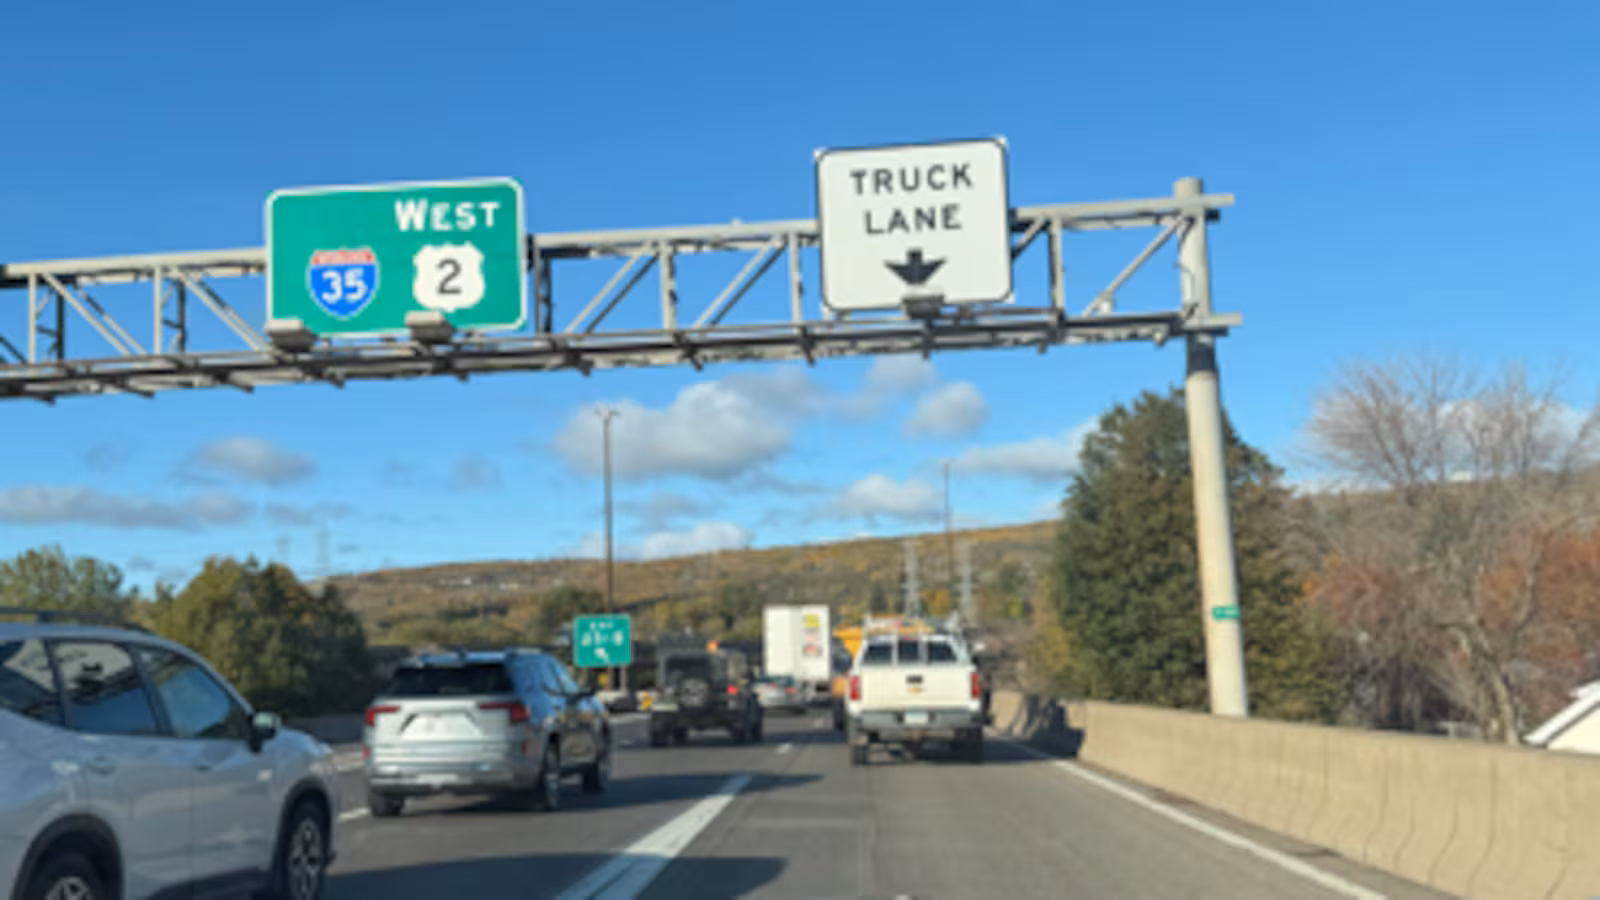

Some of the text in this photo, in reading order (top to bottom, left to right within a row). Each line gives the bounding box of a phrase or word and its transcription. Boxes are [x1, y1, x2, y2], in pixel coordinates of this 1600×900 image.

[850, 163, 972, 194] TRUCK
[395, 198, 499, 231] WEST
[865, 203, 962, 234] LANE
[321, 267, 368, 304] 35
[437, 258, 462, 294] 2
